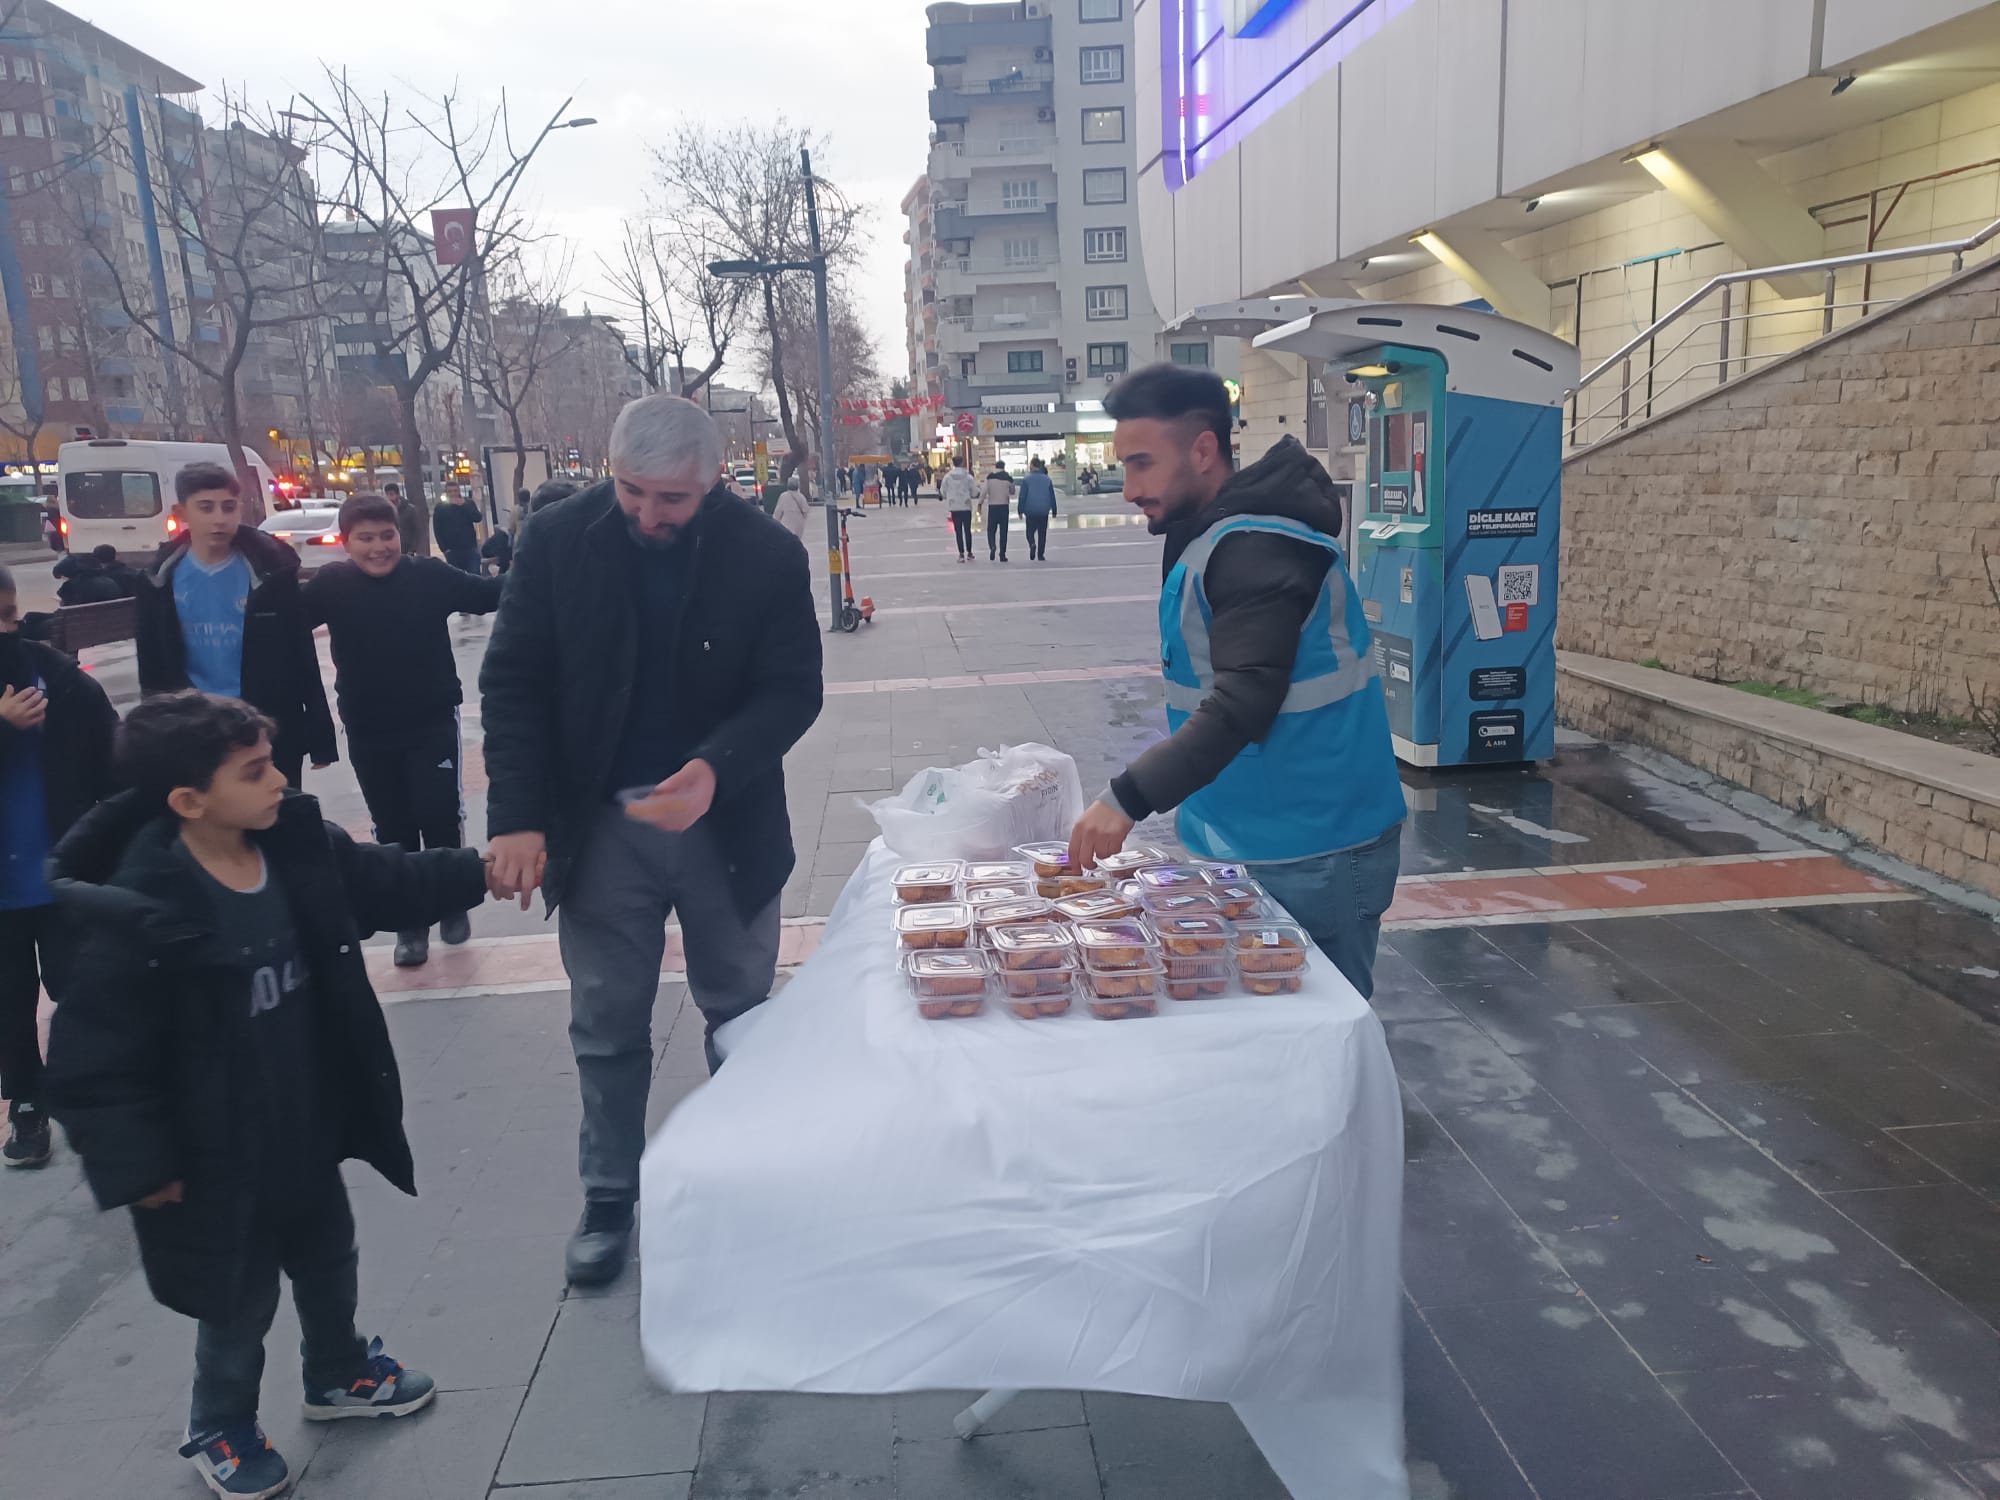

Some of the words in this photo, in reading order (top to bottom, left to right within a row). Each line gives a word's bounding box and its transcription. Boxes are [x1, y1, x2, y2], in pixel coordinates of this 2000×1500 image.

[995, 419, 1041, 429] TURKCELL
[1469, 512, 1503, 524] DİCLE
[1504, 511, 1537, 522] KART
